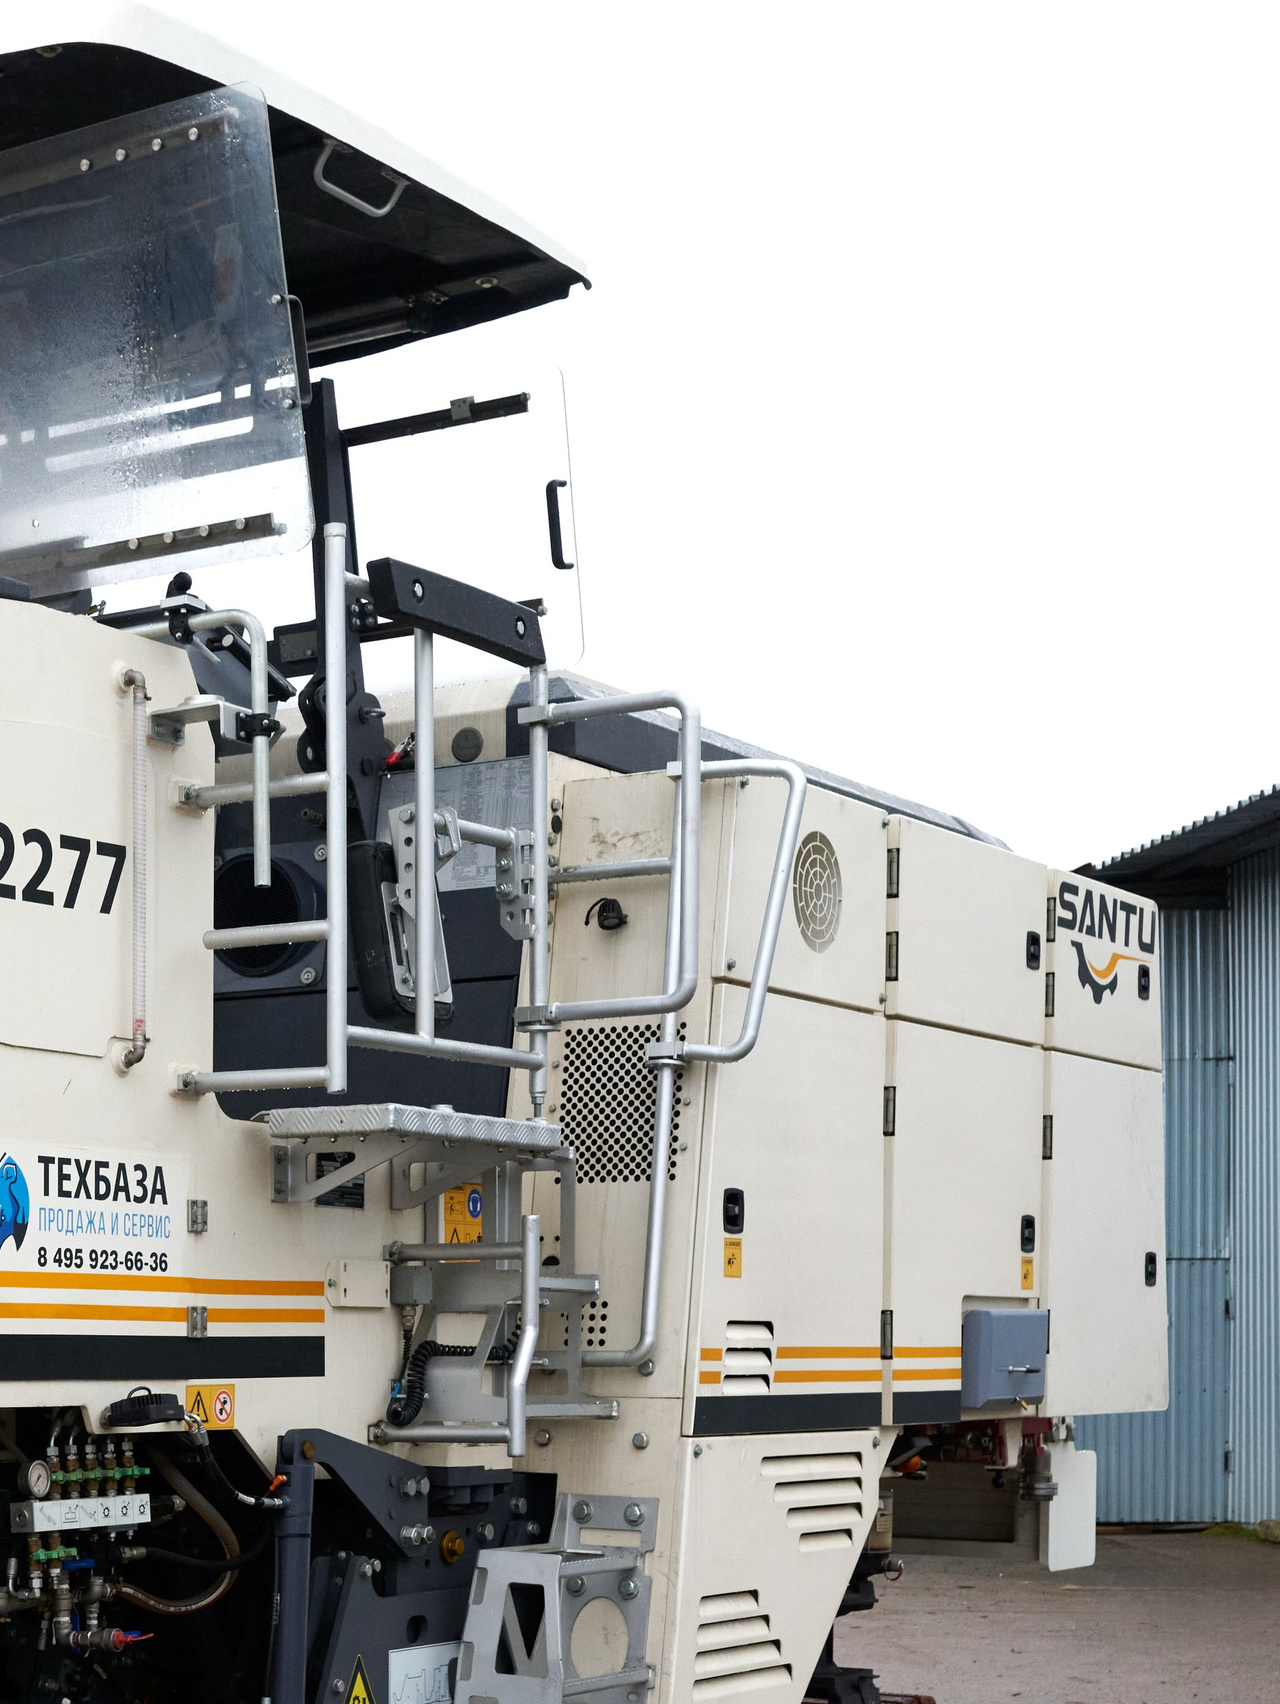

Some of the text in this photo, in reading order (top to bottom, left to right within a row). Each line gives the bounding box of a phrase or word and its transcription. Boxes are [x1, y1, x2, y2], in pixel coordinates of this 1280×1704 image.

[1057, 881, 1156, 955] SANTU
[38, 1155, 168, 1205] ТЕХБАЗА
[38, 1207, 171, 1239] ПРОДАЖА И СЕРВИС
[38, 1246, 168, 1272] 8 495 923-66-36
